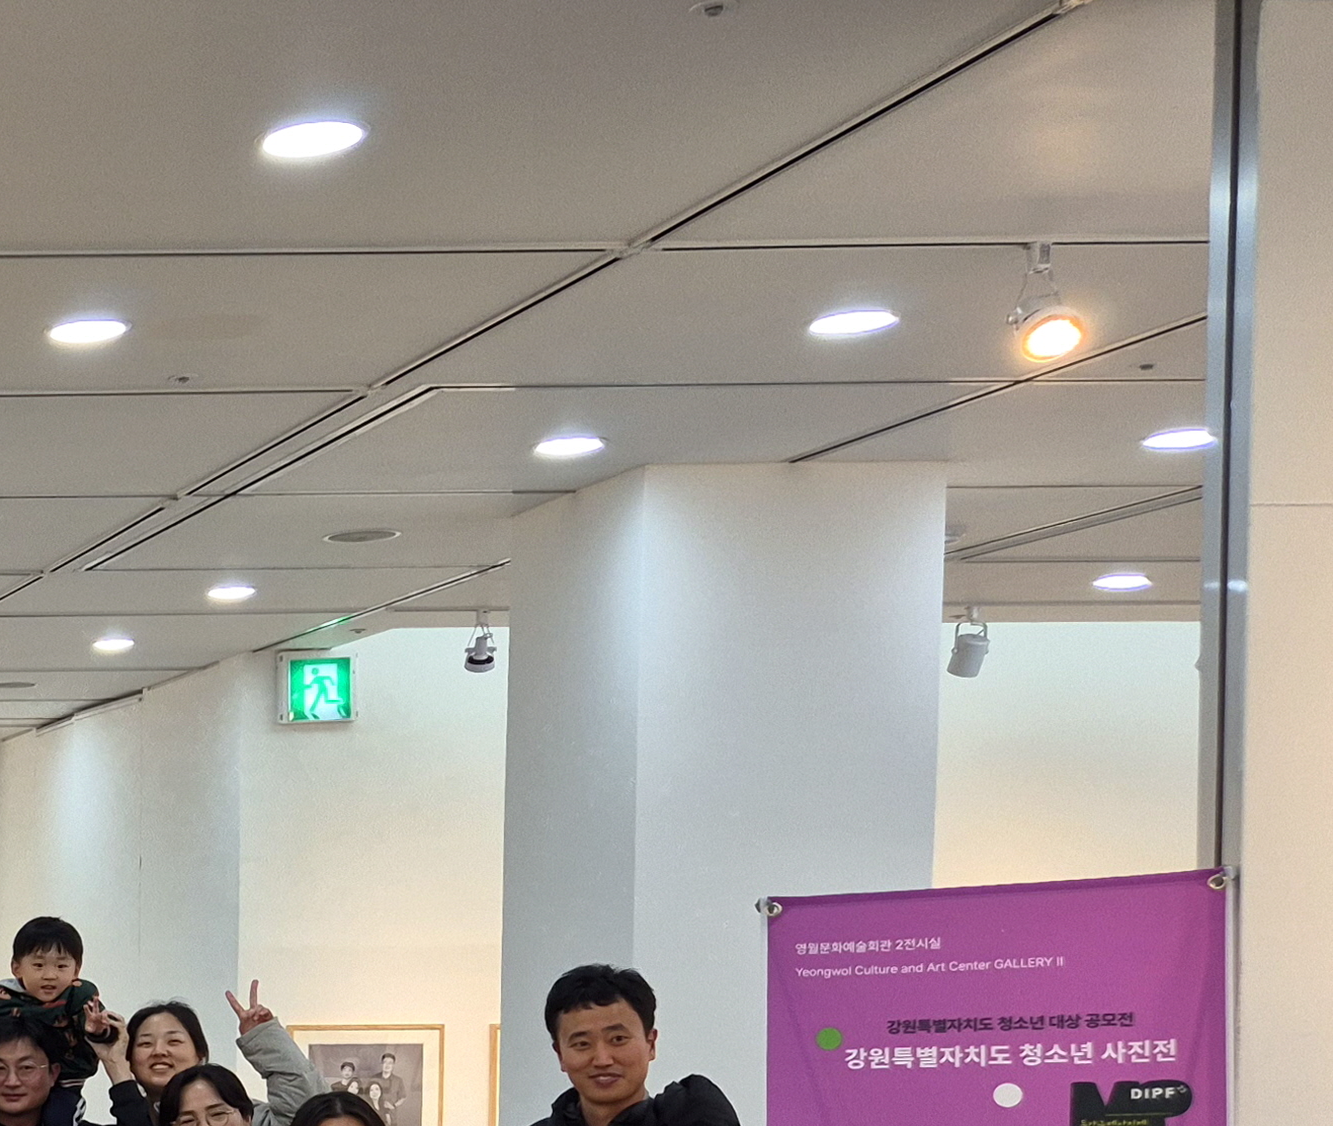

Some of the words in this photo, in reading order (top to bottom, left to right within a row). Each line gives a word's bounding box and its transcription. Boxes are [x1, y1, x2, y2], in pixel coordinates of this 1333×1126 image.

[794, 939, 892, 955] 영월문화예술회관
[895, 936, 941, 951] 2전시실
[795, 965, 852, 979] Yeongwol
[854, 963, 899, 976] Culture
[900, 962, 923, 974] and
[927, 961, 946, 973] Art
[948, 959, 991, 972] Center
[993, 956, 1052, 969] GALLERY
[886, 1016, 994, 1035] 강원특별자치도
[997, 1014, 1045, 1032] 청소년
[1048, 1012, 1082, 1030] 대상
[1084, 1011, 1135, 1029] 공모전
[844, 1043, 1013, 1070] 강원특별자치도
[1018, 1041, 1094, 1067] 청소년
[1100, 1038, 1178, 1064] 사진전
[1130, 1086, 1176, 1100] DIPF
